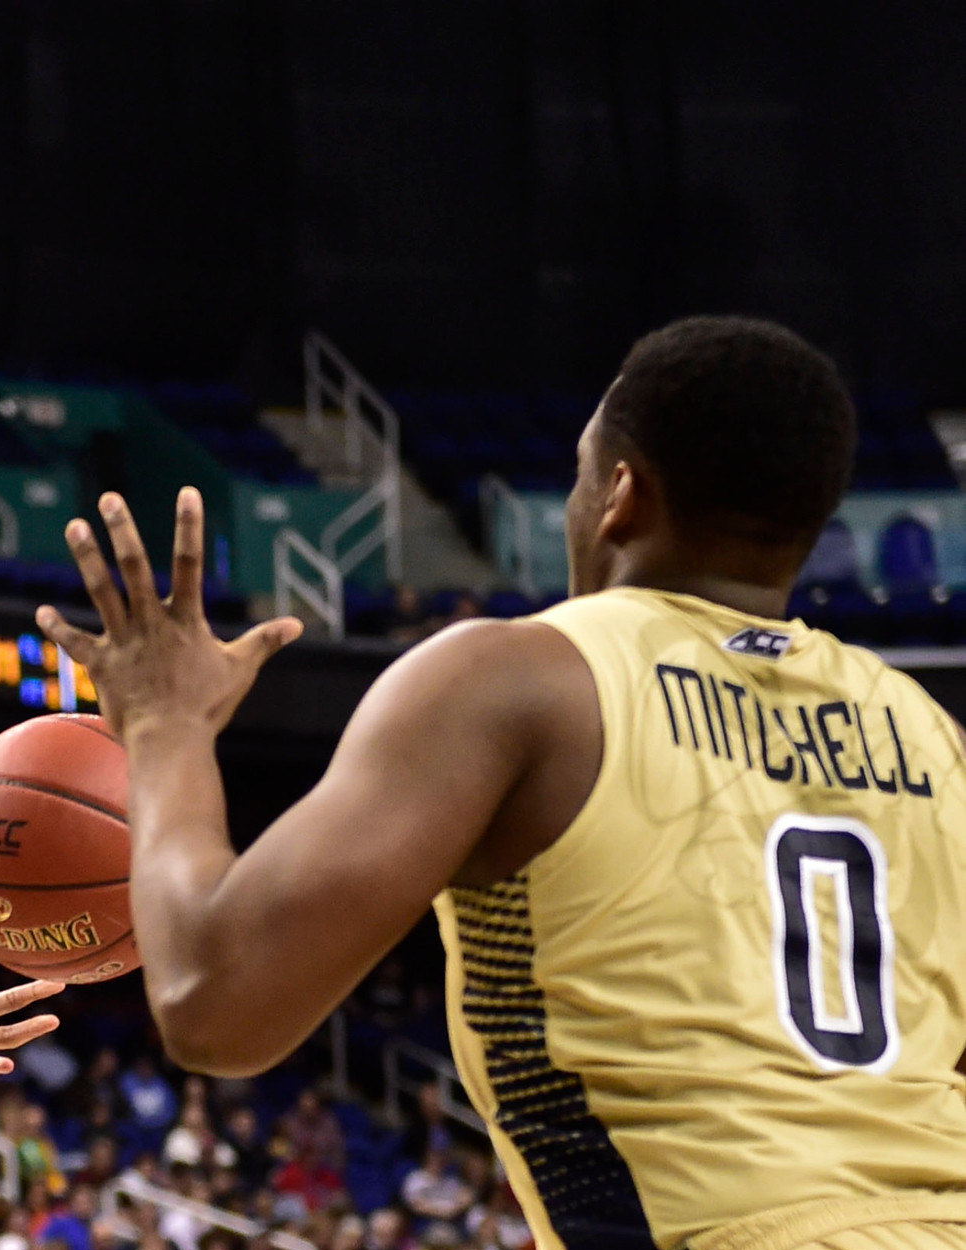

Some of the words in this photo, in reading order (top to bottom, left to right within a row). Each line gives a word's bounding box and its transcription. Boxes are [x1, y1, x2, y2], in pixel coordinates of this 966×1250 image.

[726, 629, 790, 656] ACC
[656, 664, 933, 798] MITCHELL
[765, 812, 900, 1075] 0
